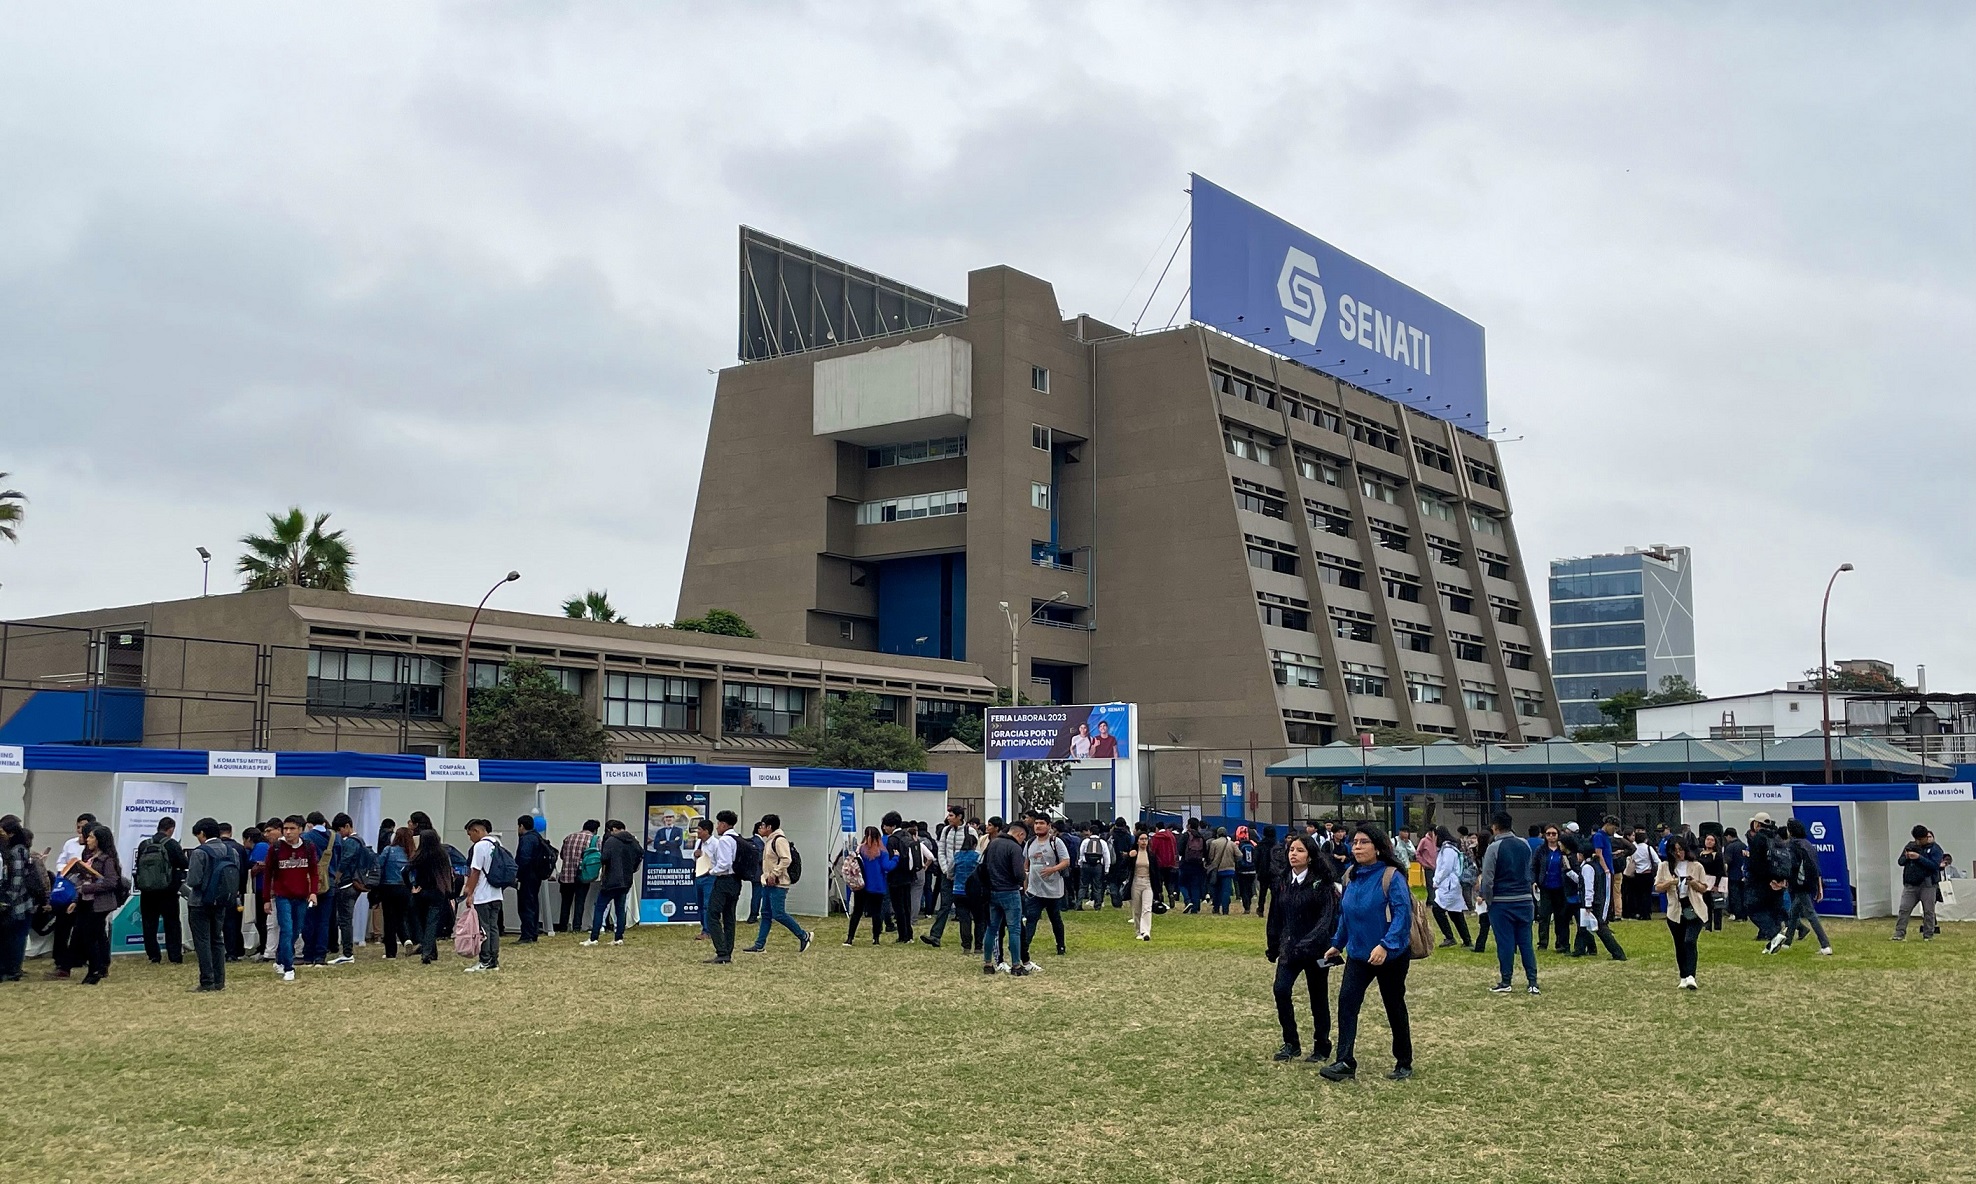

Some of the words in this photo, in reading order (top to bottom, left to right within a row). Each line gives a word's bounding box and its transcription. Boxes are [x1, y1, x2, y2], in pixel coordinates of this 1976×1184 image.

[1339, 294, 1431, 376] SENATI
[990, 714, 1013, 722] FERIA
[1013, 714, 1047, 722] LABORAL
[1047, 713, 1067, 721] 2023
[991, 730, 1029, 739] ¡GRACIAS
[1047, 729, 1058, 737] TU
[990, 737, 1055, 747] PARTICIPACIÓN!
[1927, 787, 1965, 796] ADMISIÓN
